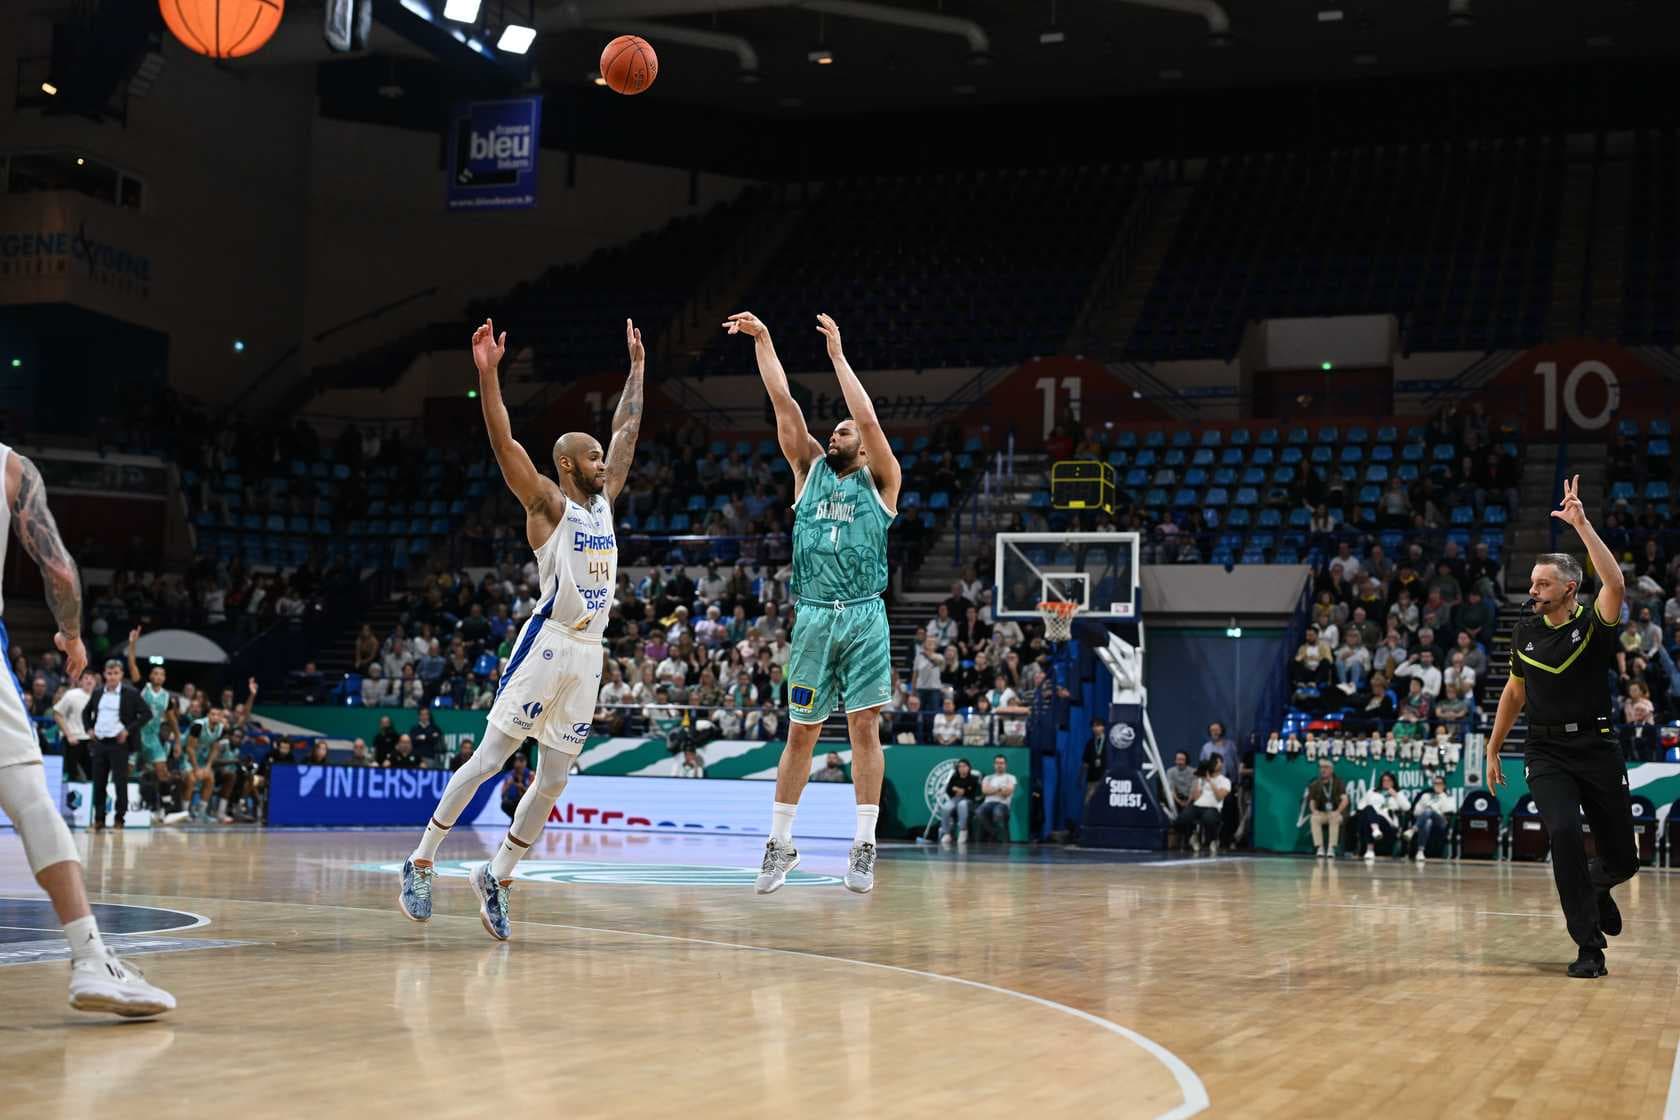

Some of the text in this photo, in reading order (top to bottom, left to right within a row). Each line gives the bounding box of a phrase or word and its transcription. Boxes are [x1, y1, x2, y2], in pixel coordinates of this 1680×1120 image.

[470, 131, 530, 159] bleu
[1534, 360, 1620, 431] 10
[1035, 376, 1082, 441] 11
[589, 560, 610, 582] 44
[1110, 779, 1132, 794] SUD
[1109, 793, 1142, 808] OUEST
